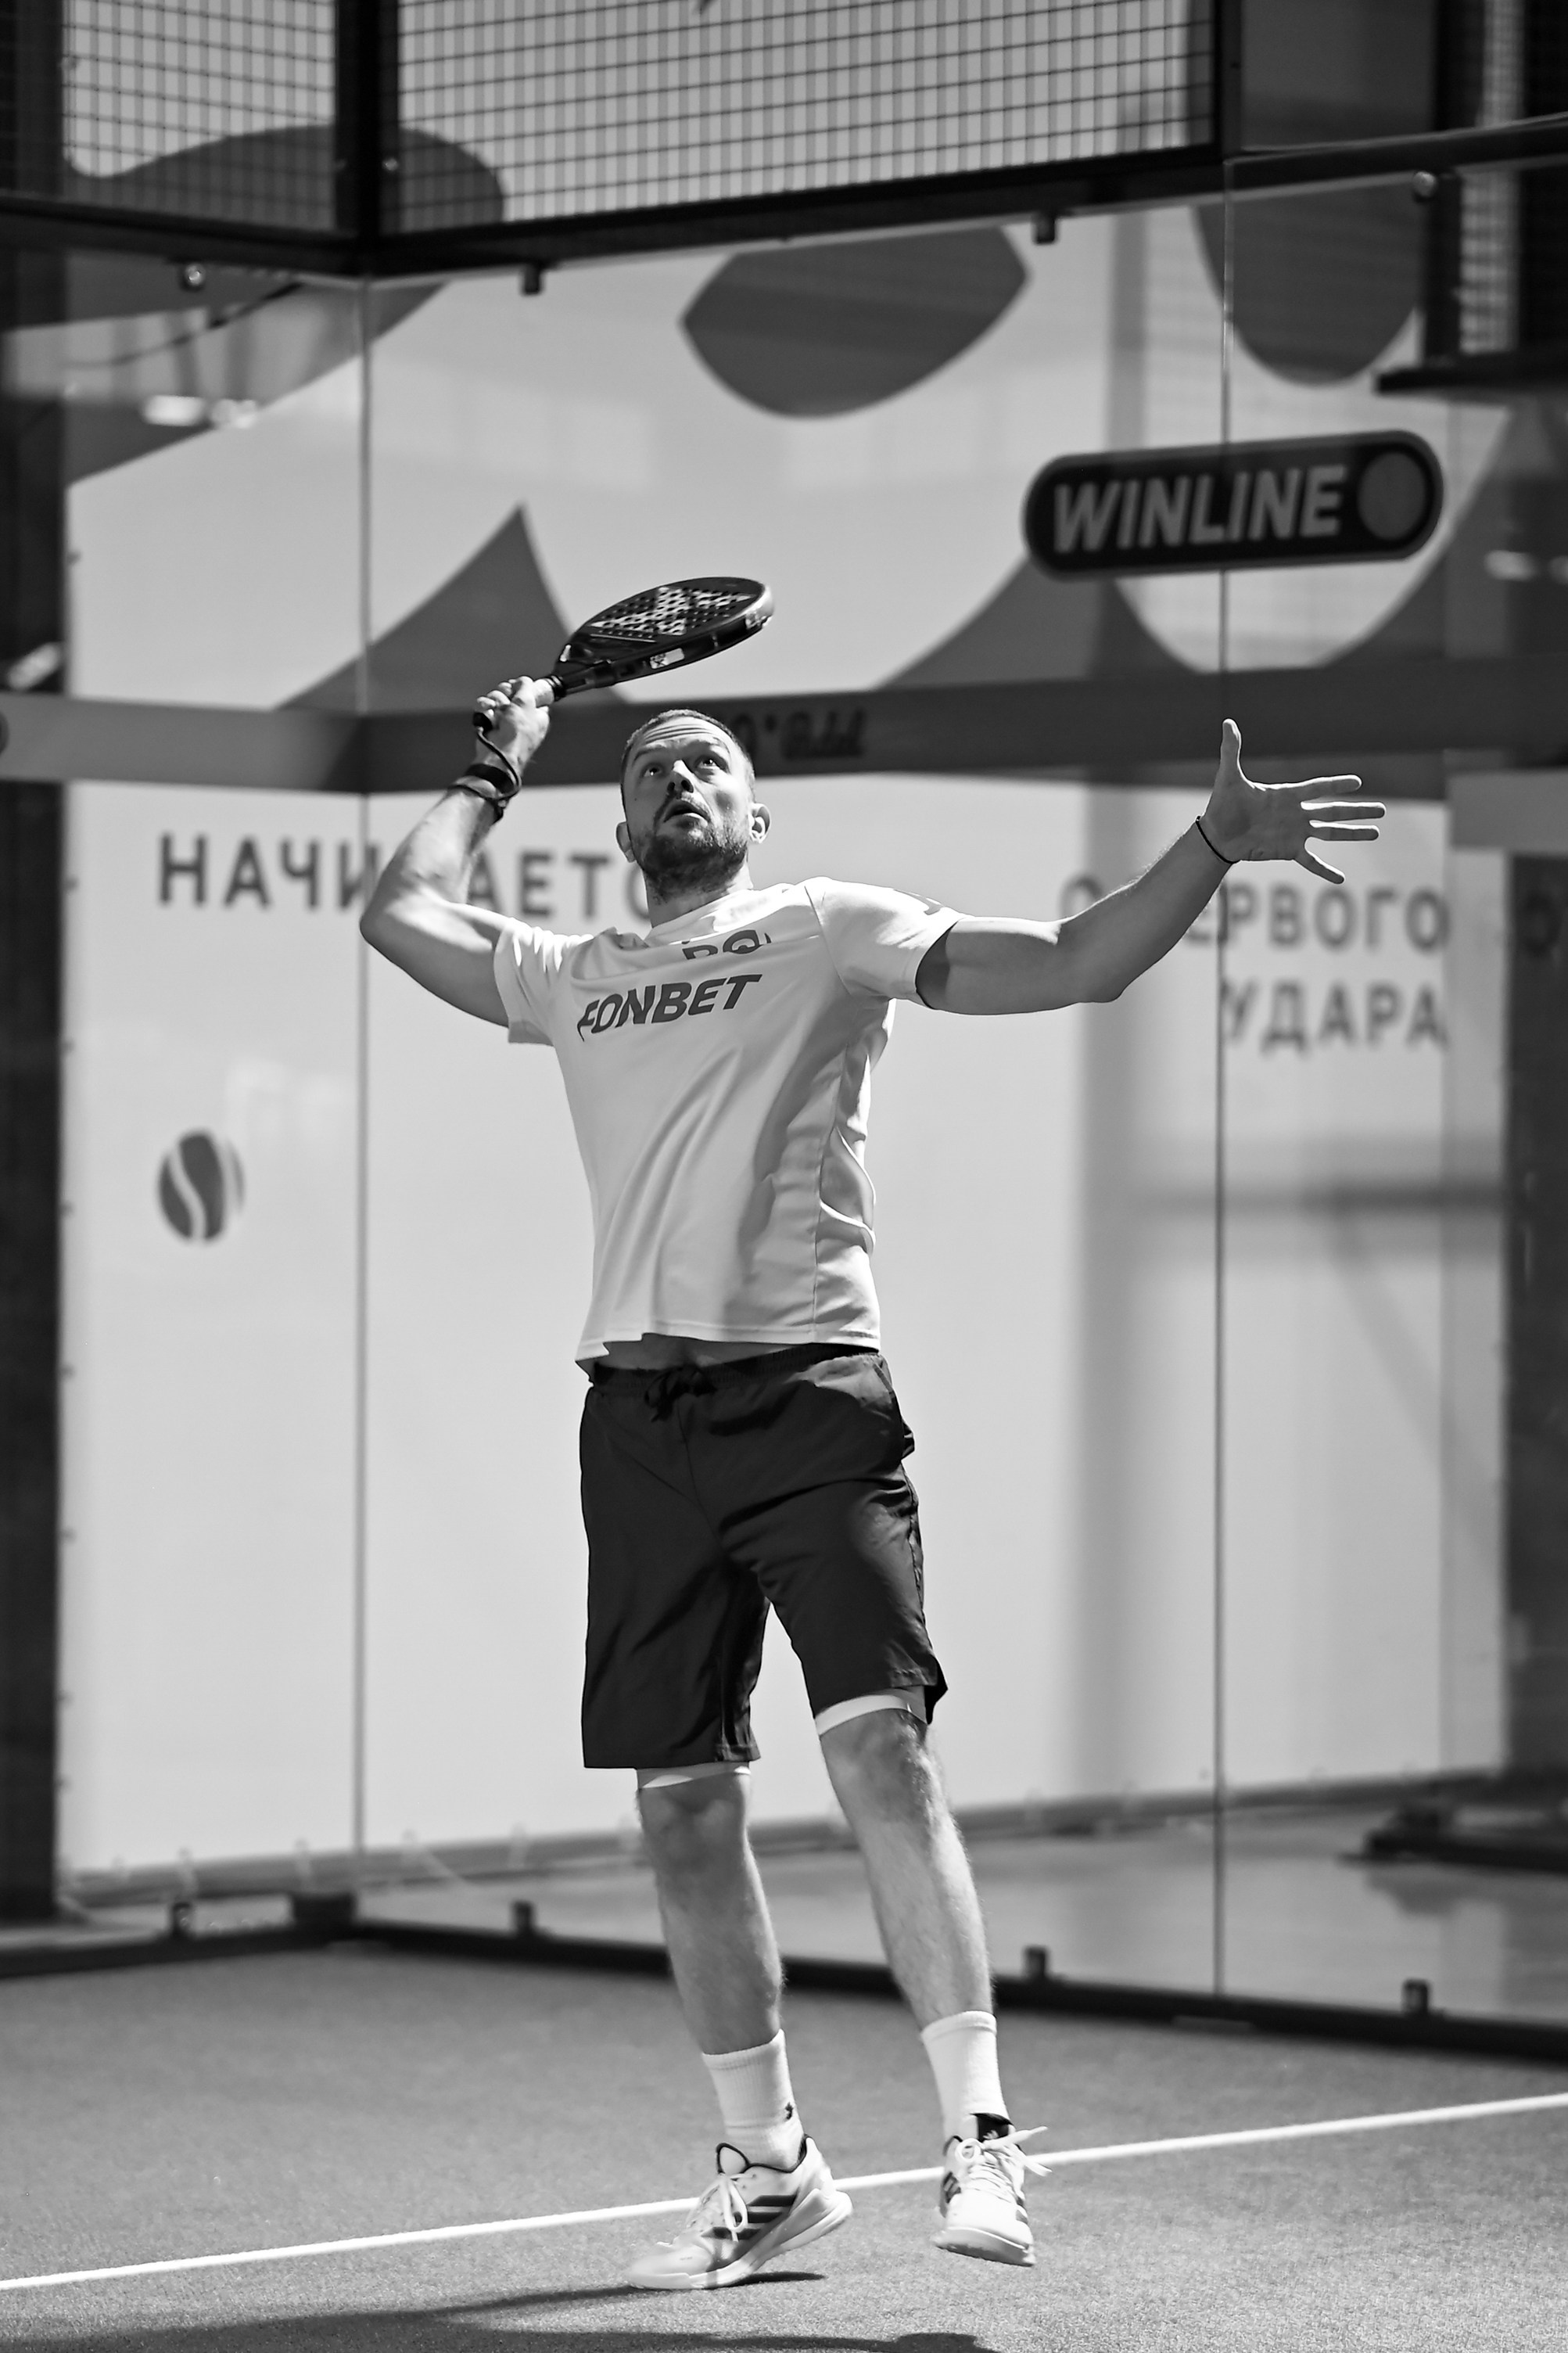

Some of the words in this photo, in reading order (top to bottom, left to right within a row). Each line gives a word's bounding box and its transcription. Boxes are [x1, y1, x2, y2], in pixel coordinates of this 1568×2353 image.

[1054, 466, 1346, 553] WINLINE
[576, 974, 763, 1042] FONBET
[1221, 979, 1451, 1058] УДАРА
